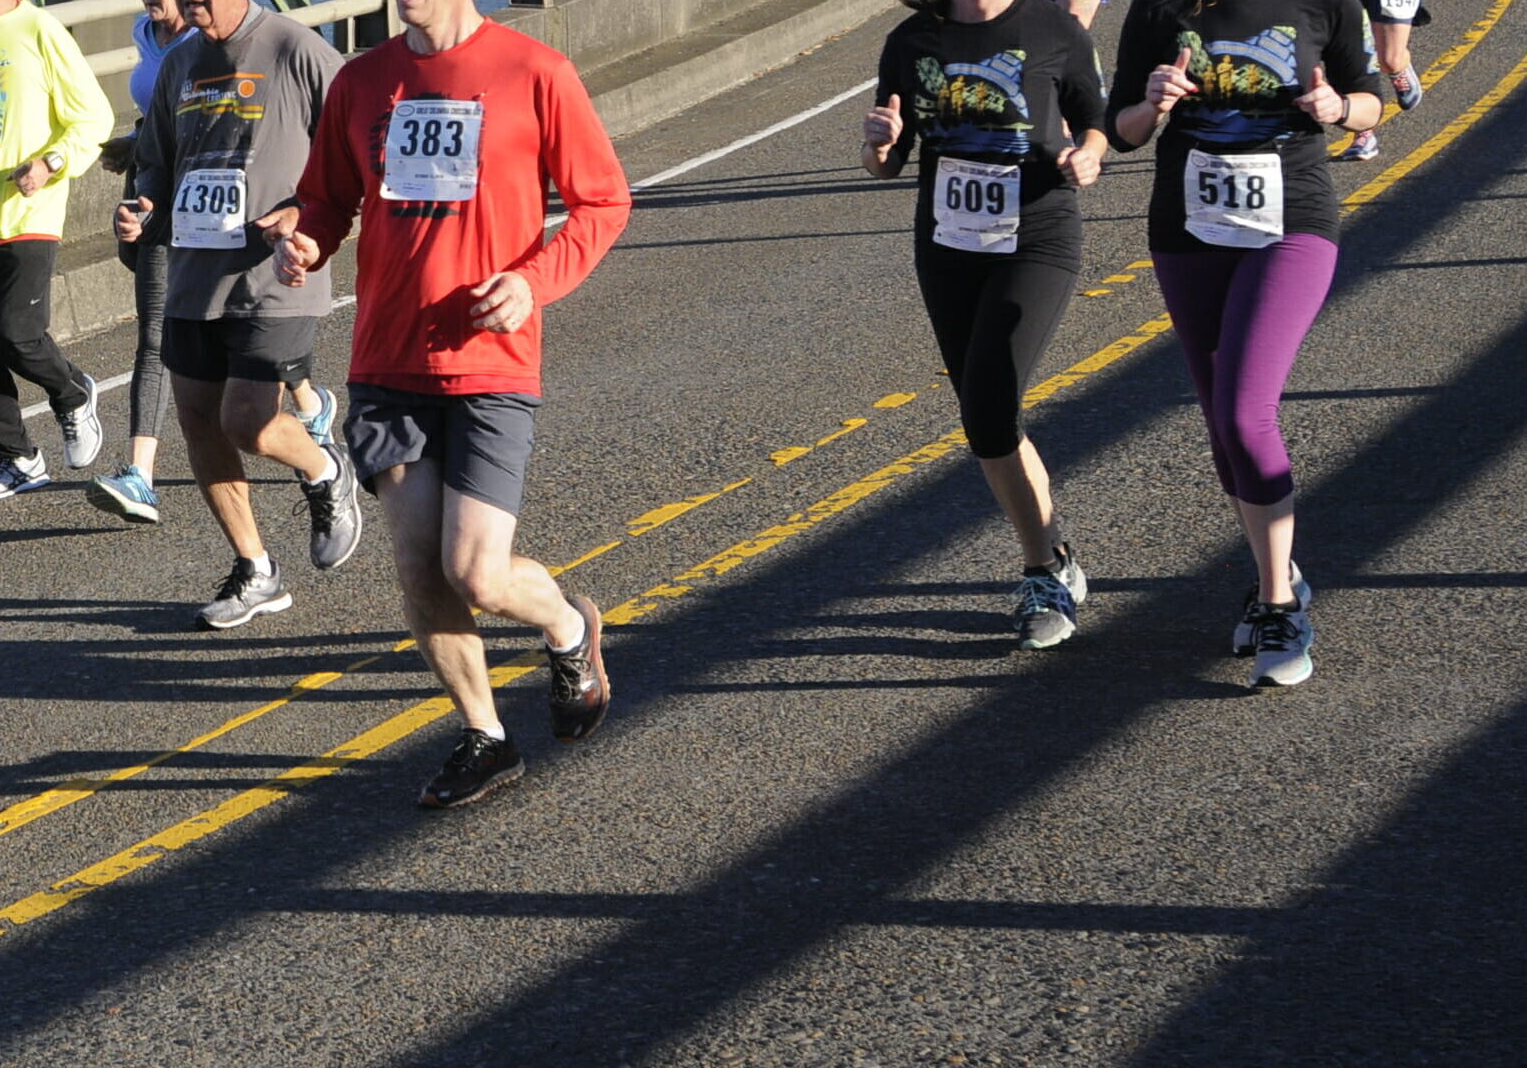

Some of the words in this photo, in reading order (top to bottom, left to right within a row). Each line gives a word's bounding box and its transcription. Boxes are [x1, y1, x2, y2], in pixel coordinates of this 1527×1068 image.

[399, 119, 464, 158] 383
[177, 184, 241, 215] 1309
[946, 176, 1004, 216] 609
[1198, 170, 1265, 210] 518
